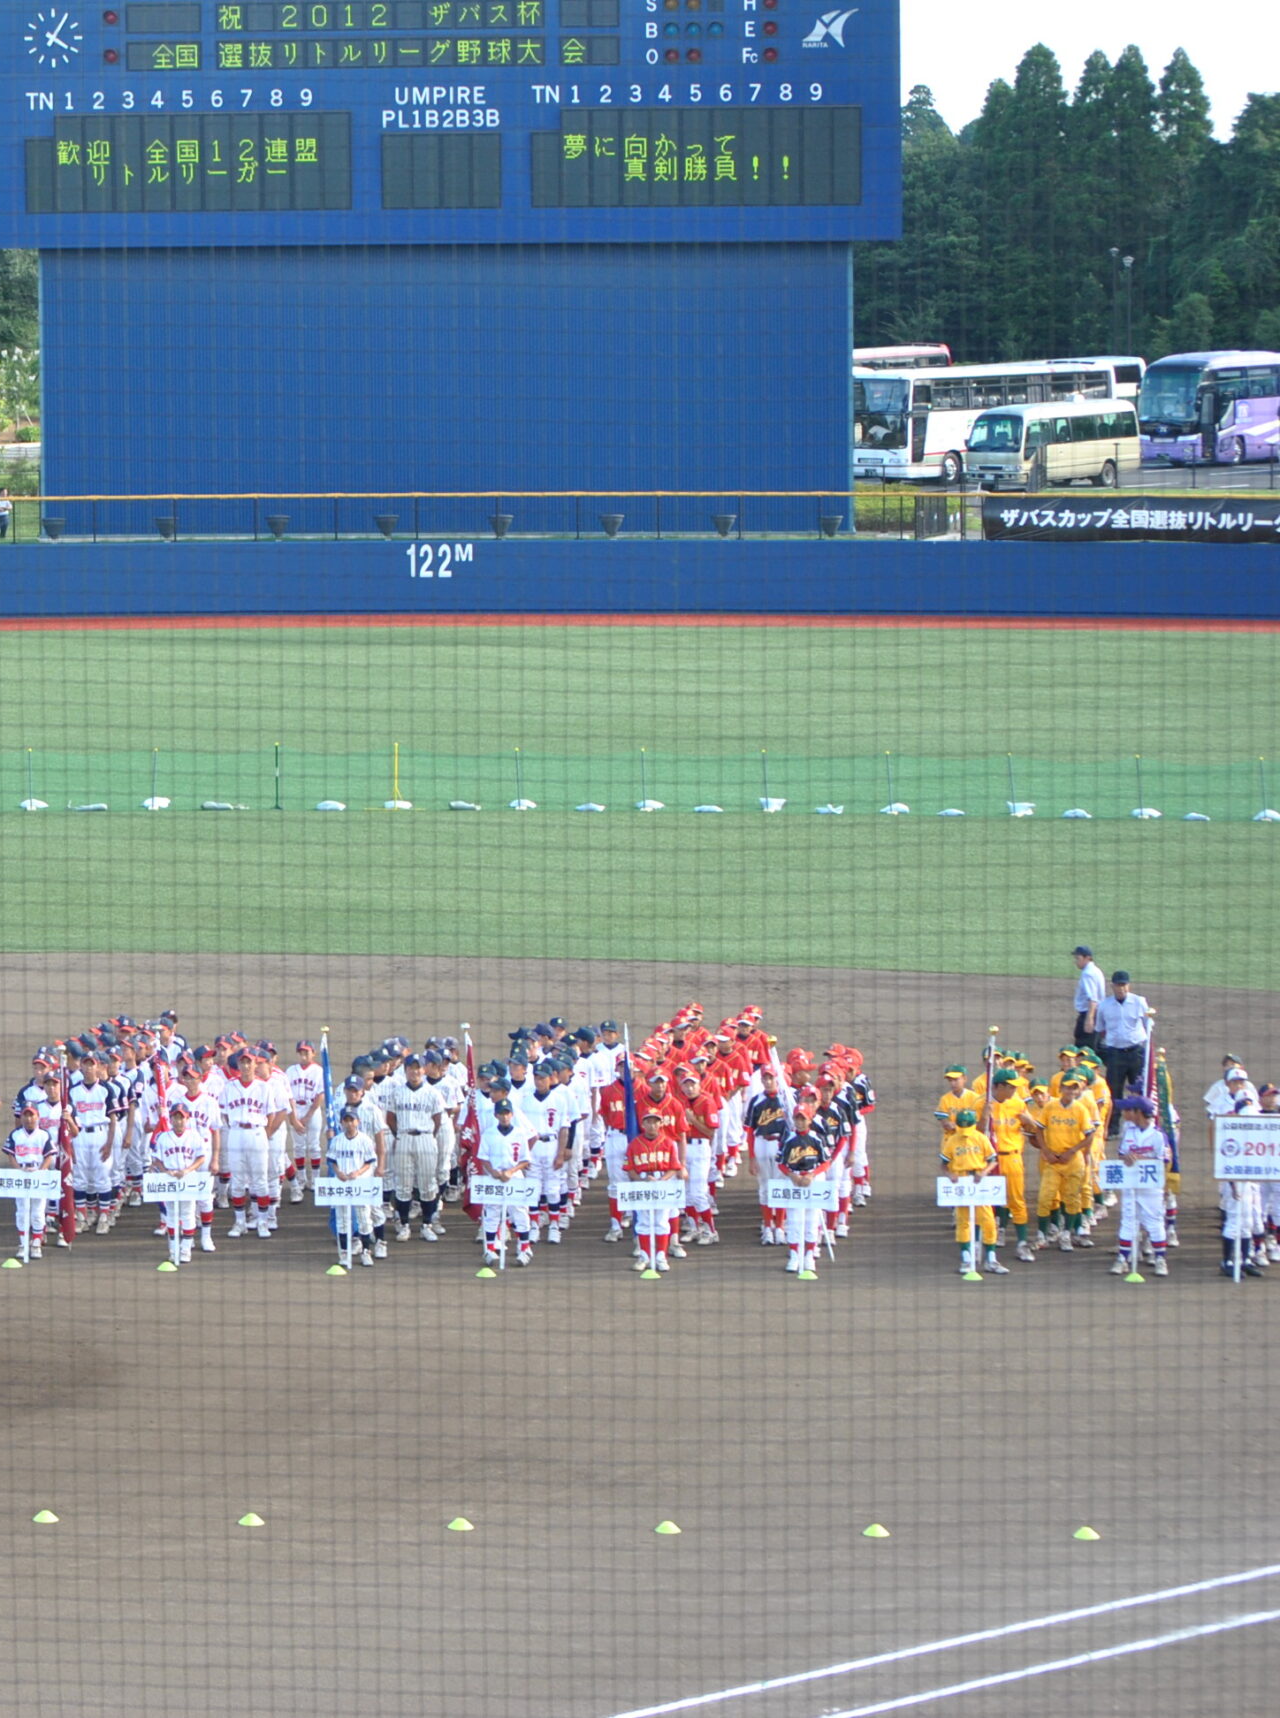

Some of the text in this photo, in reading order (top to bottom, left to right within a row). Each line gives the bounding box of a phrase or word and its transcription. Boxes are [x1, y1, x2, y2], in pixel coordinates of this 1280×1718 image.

[646, 0, 657, 12] S
[743, 0, 756, 11] H
[219, 1, 541, 31] 祝 2012 ザバス杯
[645, 22, 658, 39] B
[744, 20, 756, 37] E
[25, 91, 54, 111] TN
[394, 85, 486, 105] UMPIRE
[531, 84, 560, 104] TN
[56, 139, 111, 165] 歓迎
[562, 133, 737, 159] 夢に向かって
[92, 162, 288, 186] リトルリーガー
[1243, 1142, 1280, 1156] 201
[147, 1181, 206, 1193] 仙台西リーグ
[318, 1186, 380, 1198] 熊本中央リーグ
[474, 1184, 535, 1197] 宇都宮リーグ
[772, 1188, 831, 1200] 広島西リーグ
[942, 1186, 1001, 1197] 平塚リーグ
